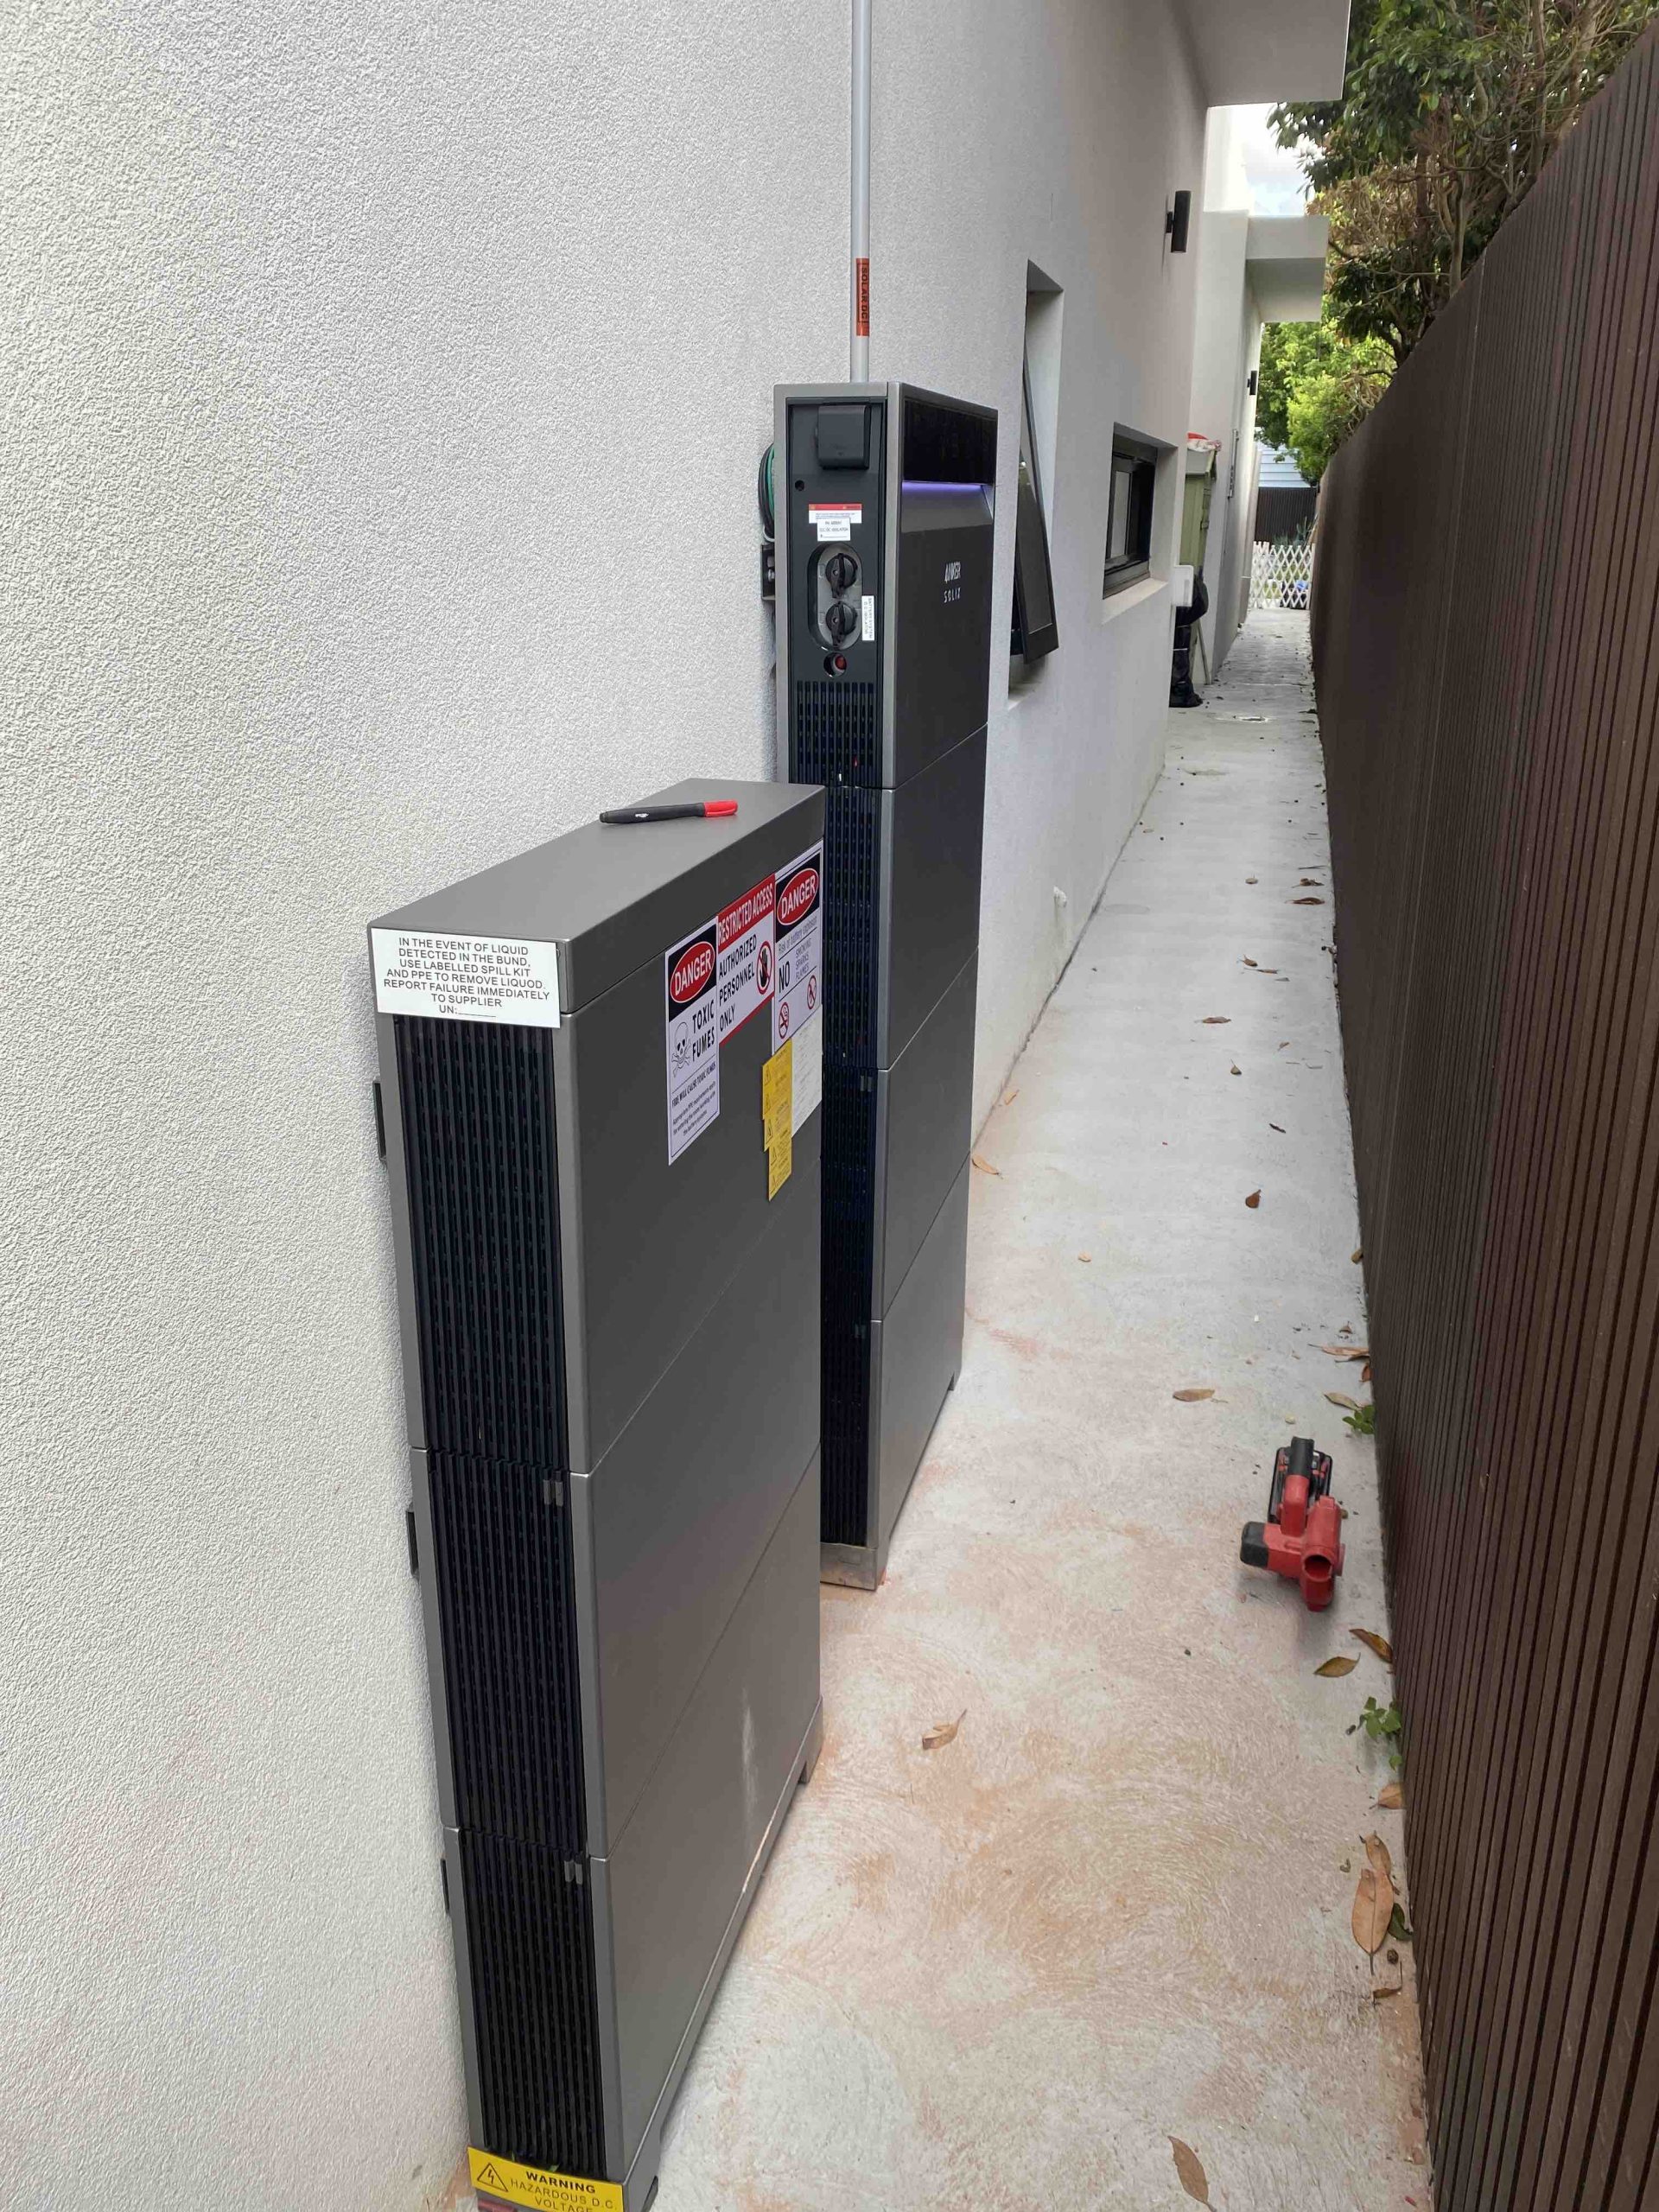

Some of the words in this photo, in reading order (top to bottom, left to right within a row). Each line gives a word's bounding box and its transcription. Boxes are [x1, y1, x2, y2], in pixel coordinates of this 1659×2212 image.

[861, 304, 868, 319] DC
[944, 588, 961, 603] SOLIX
[781, 874, 816, 919] DANGER
[718, 899, 753, 947] RESTRICTED
[753, 883, 773, 916] ACCESS
[398, 949, 456, 961] DETECTED
[459, 953, 470, 962] IN
[472, 954, 494, 963] THE
[497, 957, 531, 967] BUND,
[399, 938, 410, 947] IN
[411, 938, 433, 949] THE
[435, 940, 471, 951] EVENT
[474, 943, 488, 952] OF
[492, 944, 529, 956] LIQUID
[718, 934, 757, 980] AUTHORIZED
[386, 969, 409, 978] AND
[411, 970, 433, 981] PPE
[435, 972, 449, 982] TO
[452, 974, 499, 986] REMOVE
[400, 959, 421, 969] USE
[423, 961, 479, 973] LABELLED
[481, 966, 512, 976] SPILL
[513, 968, 531, 977] KIT
[675, 949, 711, 996] DANGER
[779, 961, 791, 994] NO
[384, 979, 428, 991] REPORT
[429, 982, 475, 995] FAILURE
[477, 987, 550, 1001] IMMEDIATELY
[719, 962, 755, 1007] PERSONNEL
[431, 994, 446, 1003] TO
[448, 995, 502, 1007] SUPPLIER
[692, 999, 715, 1034] TOXIC
[720, 1002, 735, 1032] ONLY
[692, 1026, 715, 1063] FUMES
[687, 1078, 697, 1094] CAUSE
[511, 2177, 588, 2204] HAZARDOUS
[592, 2197, 618, 2210] D.C.
[526, 2171, 595, 2194] WARNING
